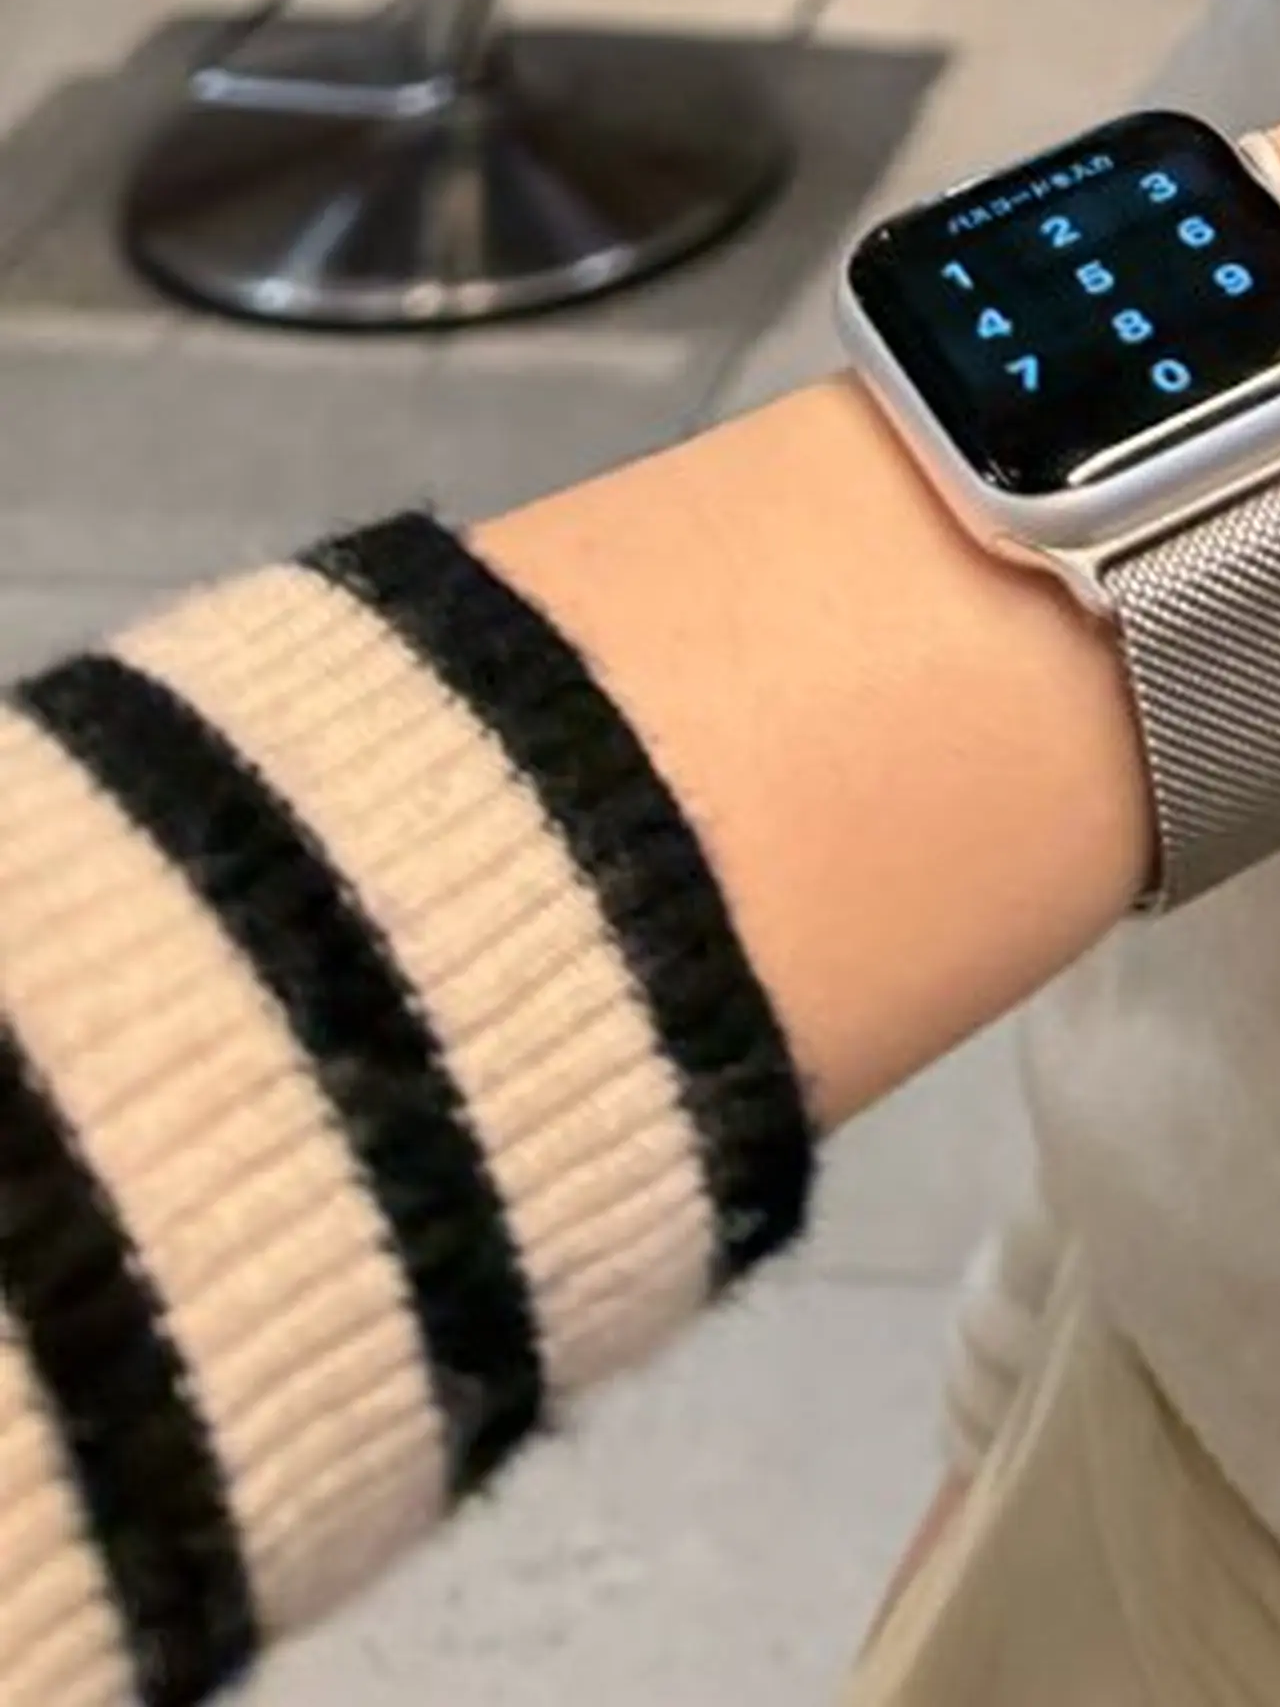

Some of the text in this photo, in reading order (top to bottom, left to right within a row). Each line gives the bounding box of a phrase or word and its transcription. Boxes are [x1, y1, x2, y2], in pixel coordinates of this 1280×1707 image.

[941, 171, 1178, 289] 1 2 3
[975, 215, 1216, 340] 4 5 6
[1006, 262, 1253, 391] 7 8 9
[1151, 359, 1191, 393] 0
